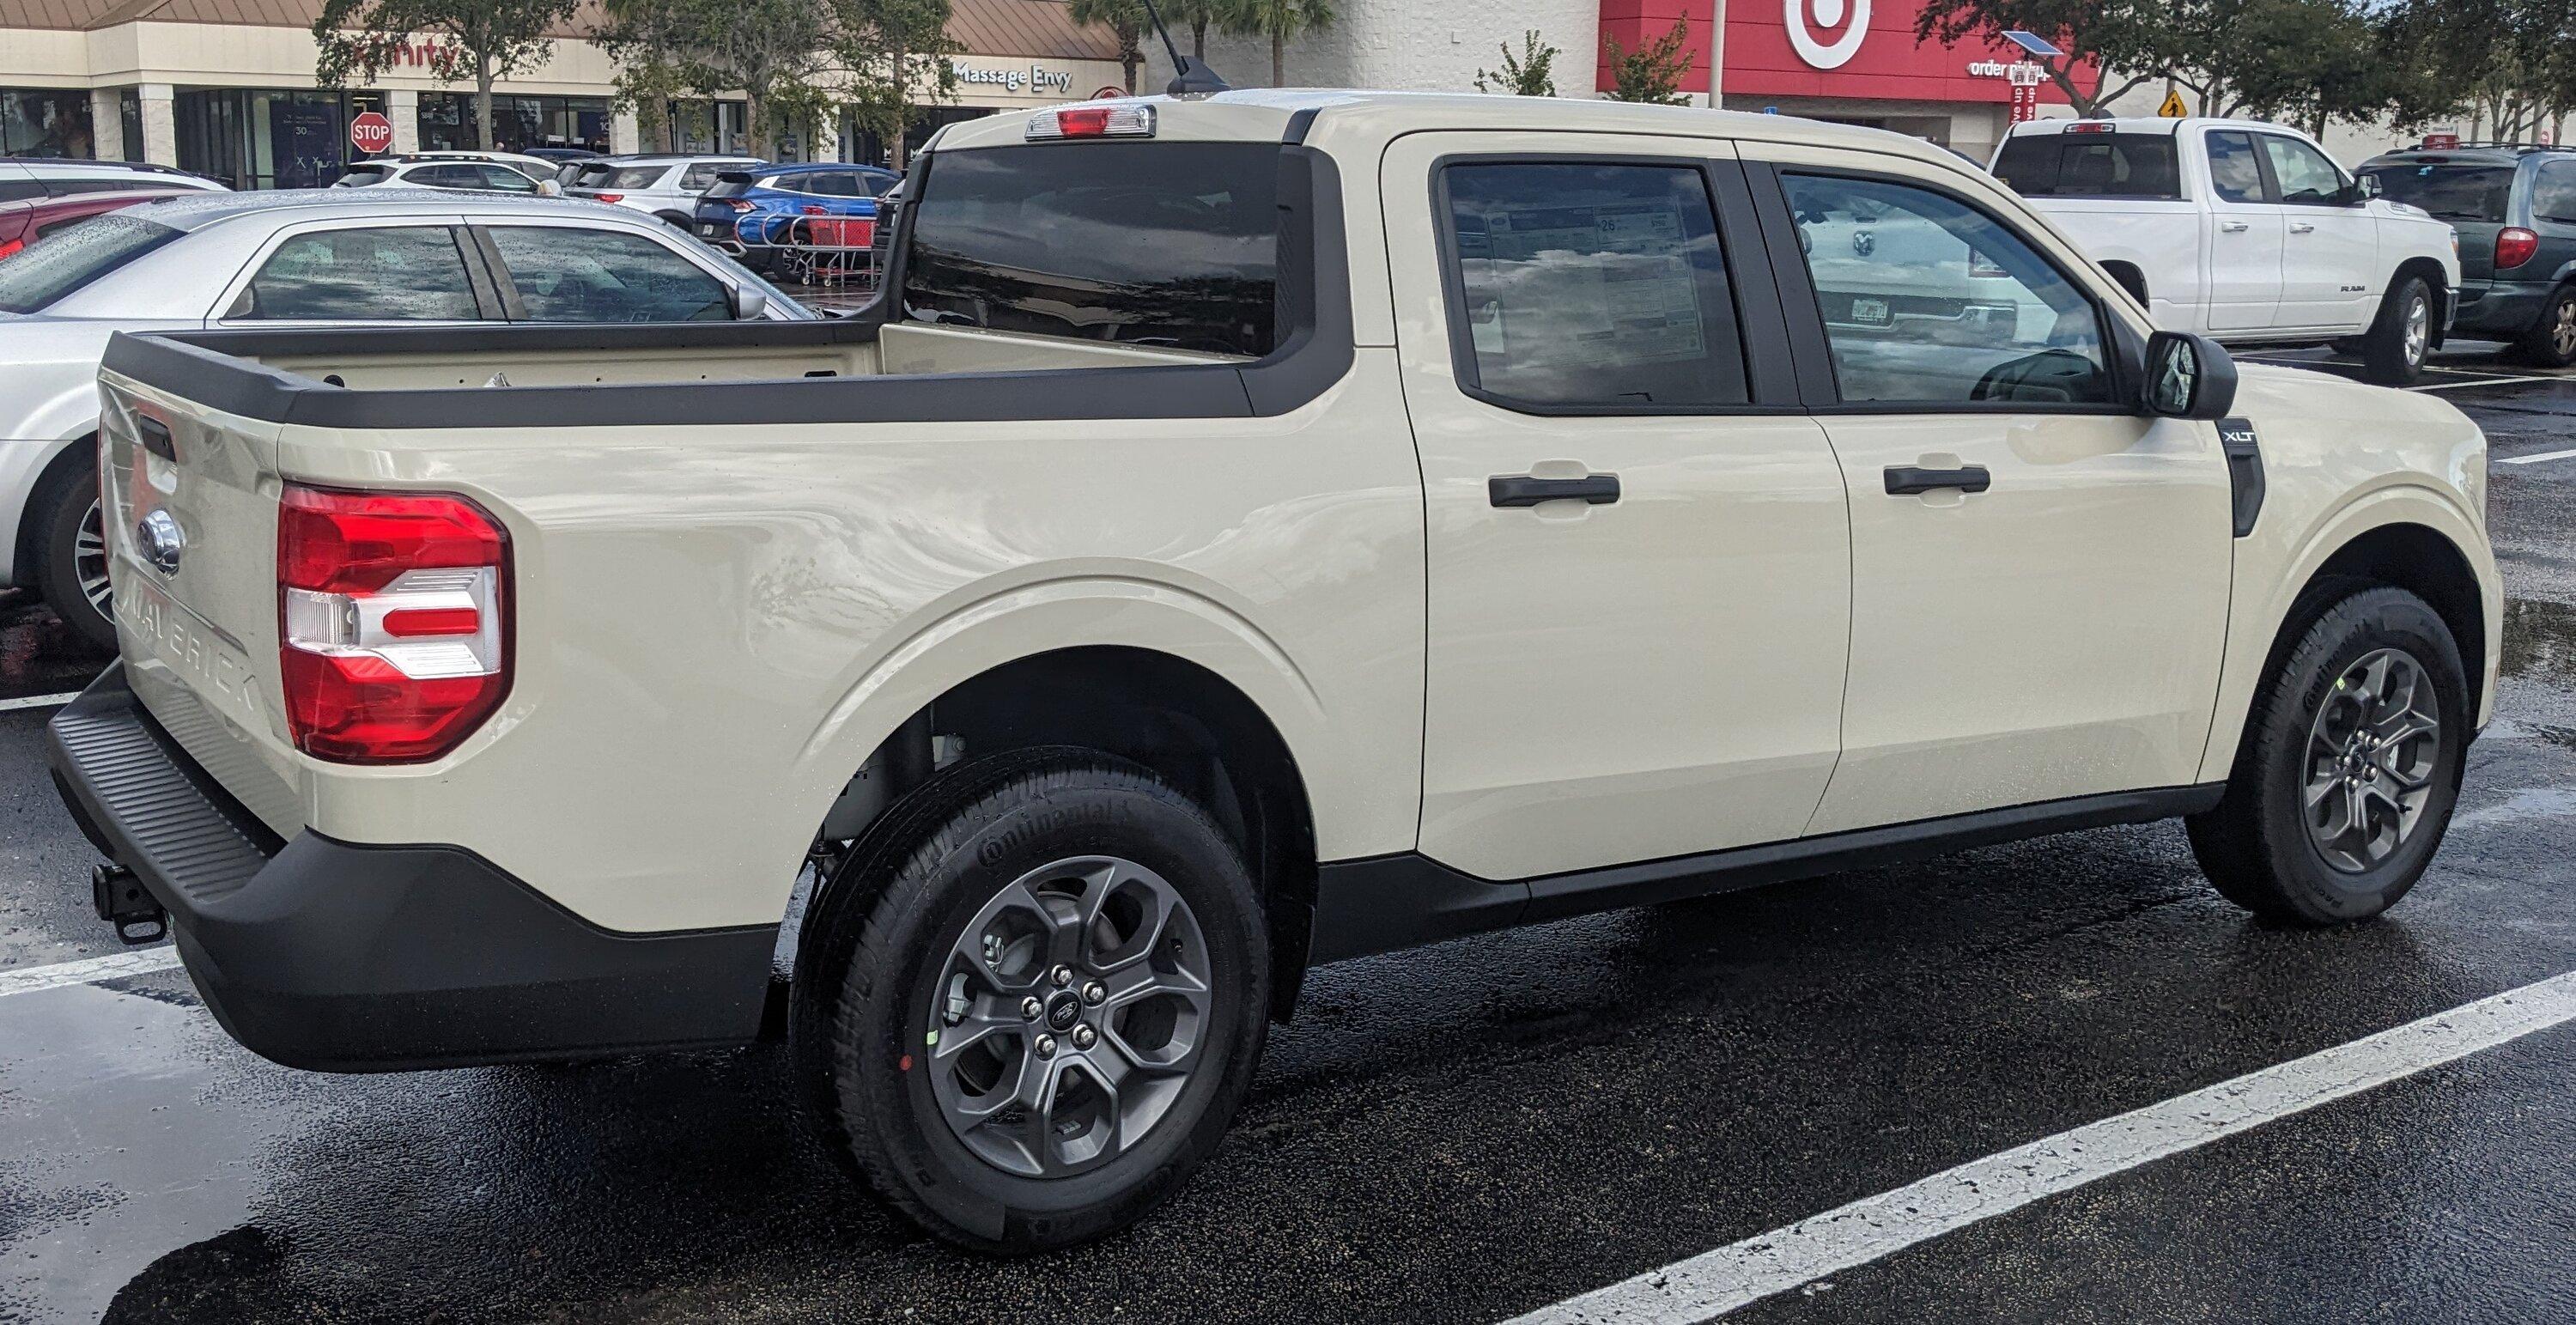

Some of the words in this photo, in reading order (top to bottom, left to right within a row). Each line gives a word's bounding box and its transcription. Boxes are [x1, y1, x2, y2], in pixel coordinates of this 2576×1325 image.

[1968, 59, 2007, 76] order
[952, 62, 1028, 91] Massage
[1031, 64, 1072, 93] Envy
[2014, 87, 2024, 103] up
[2027, 87, 2036, 103] up
[295, 126, 307, 136] 30
[355, 125, 389, 140] STOP
[1601, 219, 1615, 232] 26
[2223, 431, 2255, 441] XLT
